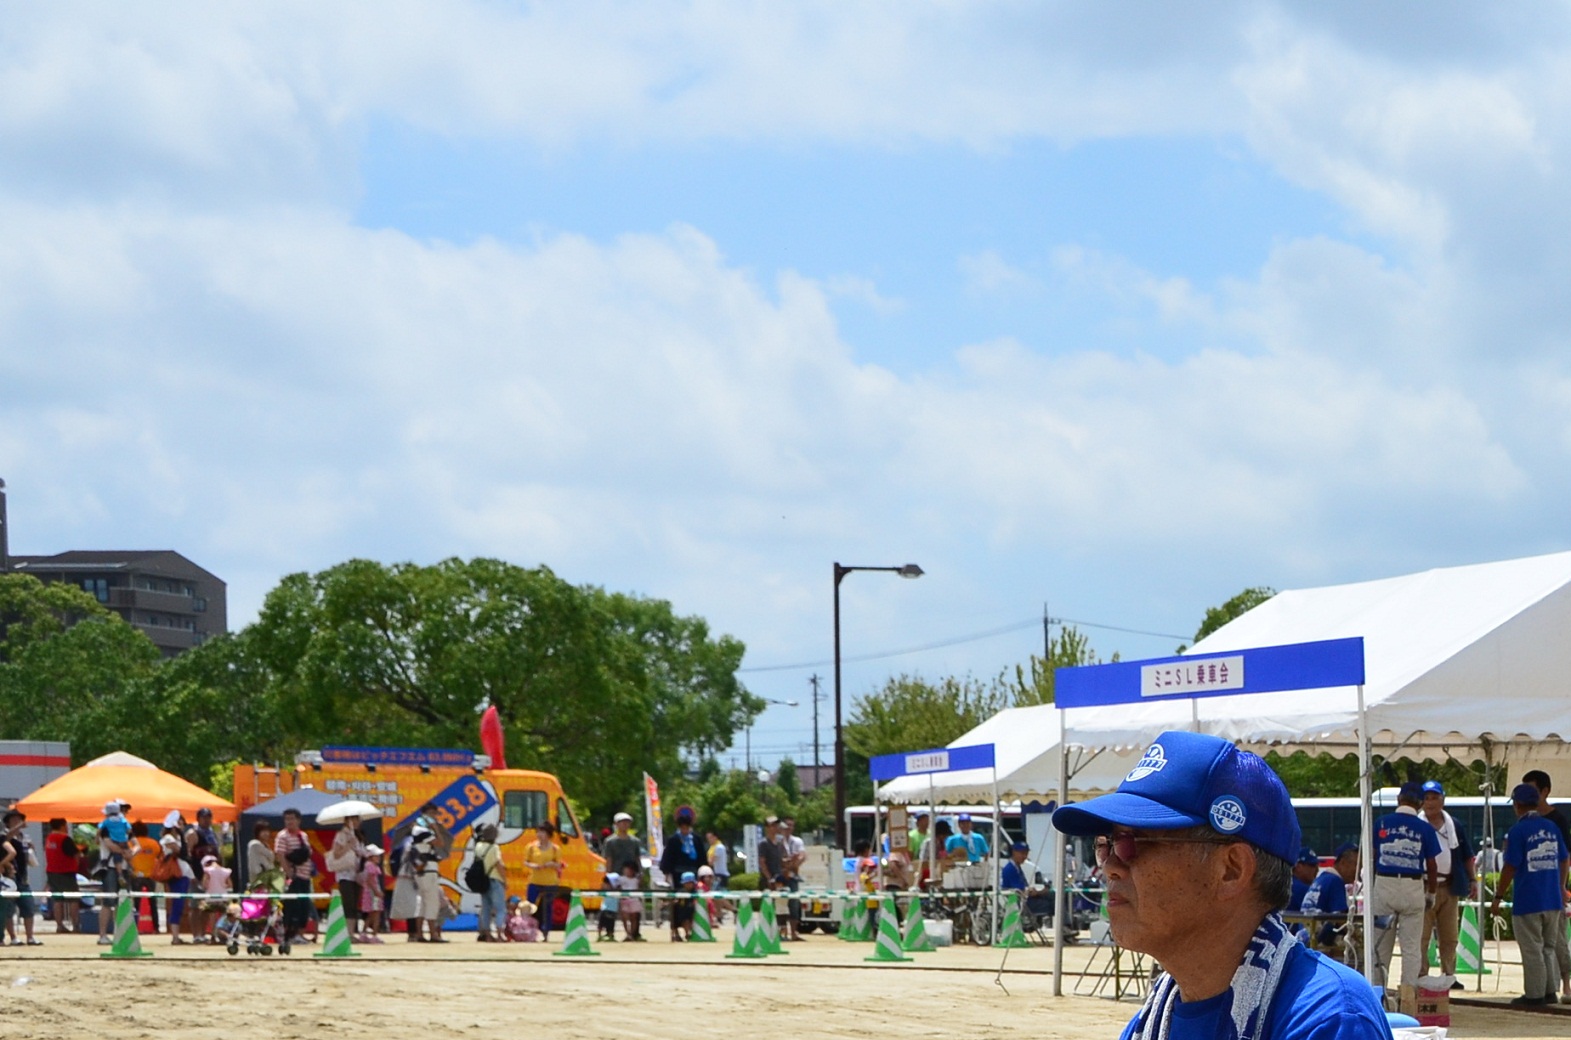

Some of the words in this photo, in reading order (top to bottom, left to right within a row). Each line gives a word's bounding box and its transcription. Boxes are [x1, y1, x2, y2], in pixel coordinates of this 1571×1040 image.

[1155, 661, 1229, 688] ミニSL乗車会
